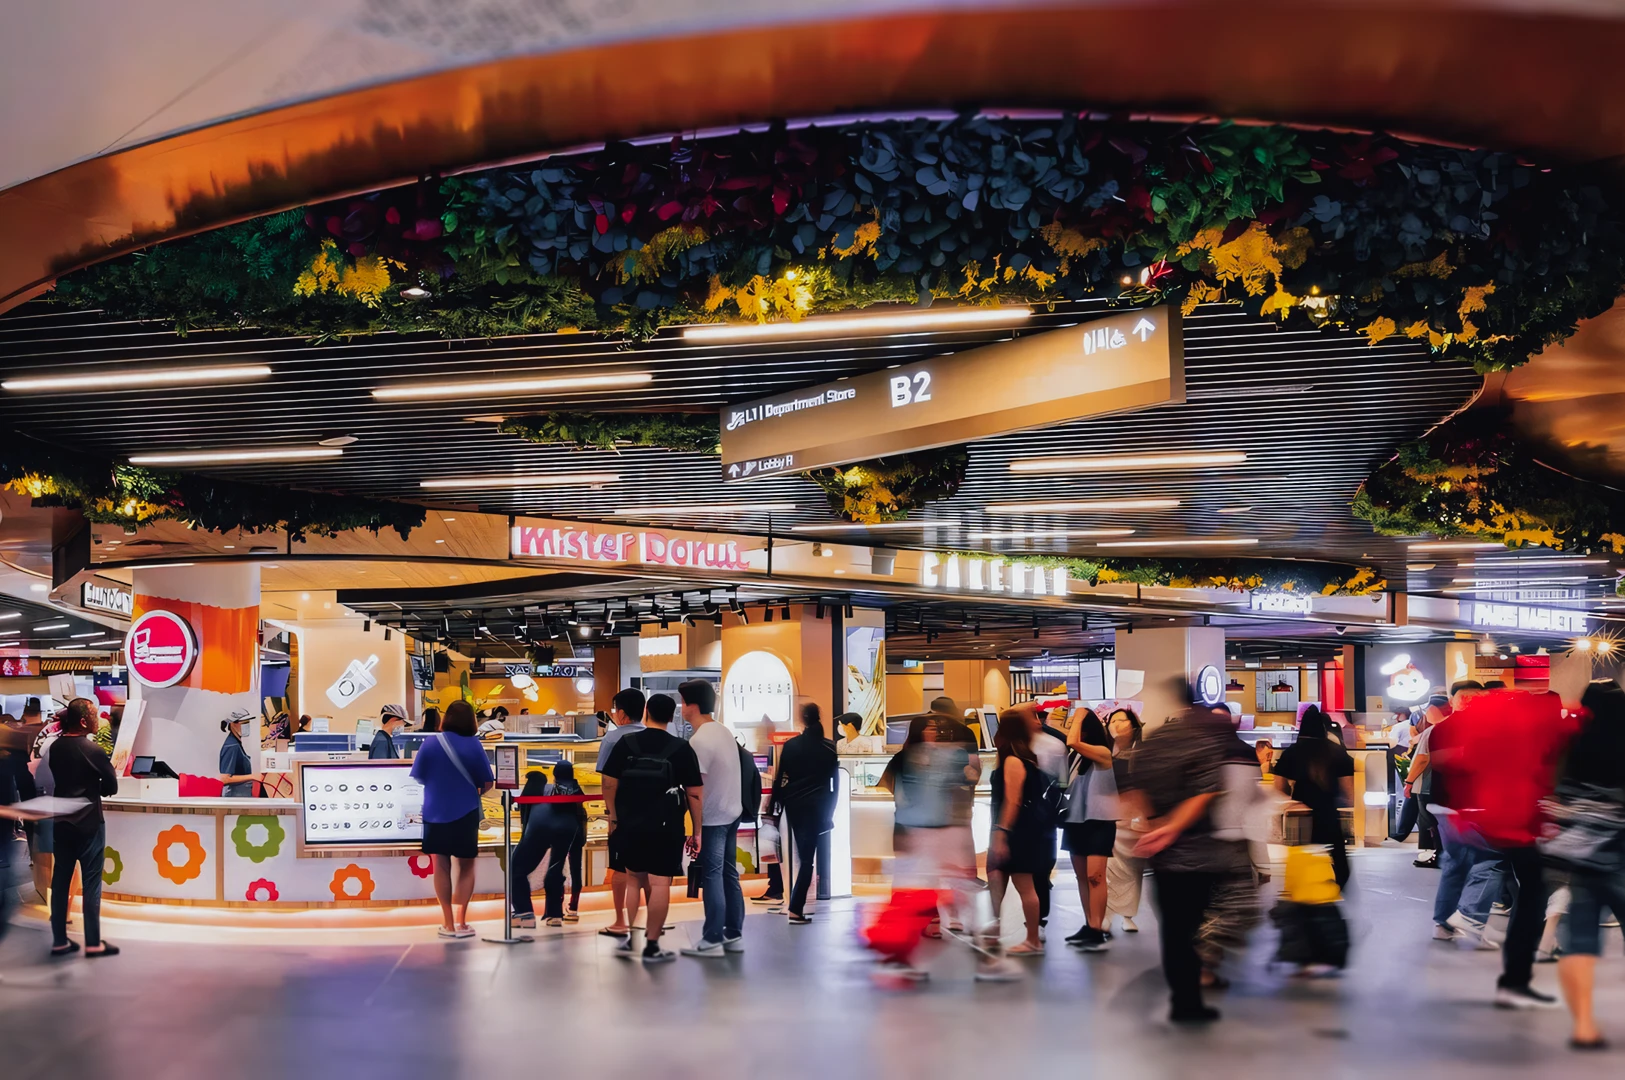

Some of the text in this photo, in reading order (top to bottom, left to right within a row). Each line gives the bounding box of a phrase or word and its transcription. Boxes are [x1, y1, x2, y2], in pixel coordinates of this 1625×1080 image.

[765, 393, 825, 417] Department
[827, 388, 856, 402] Store
[890, 371, 931, 407] B2
[758, 457, 784, 471] Lobby
